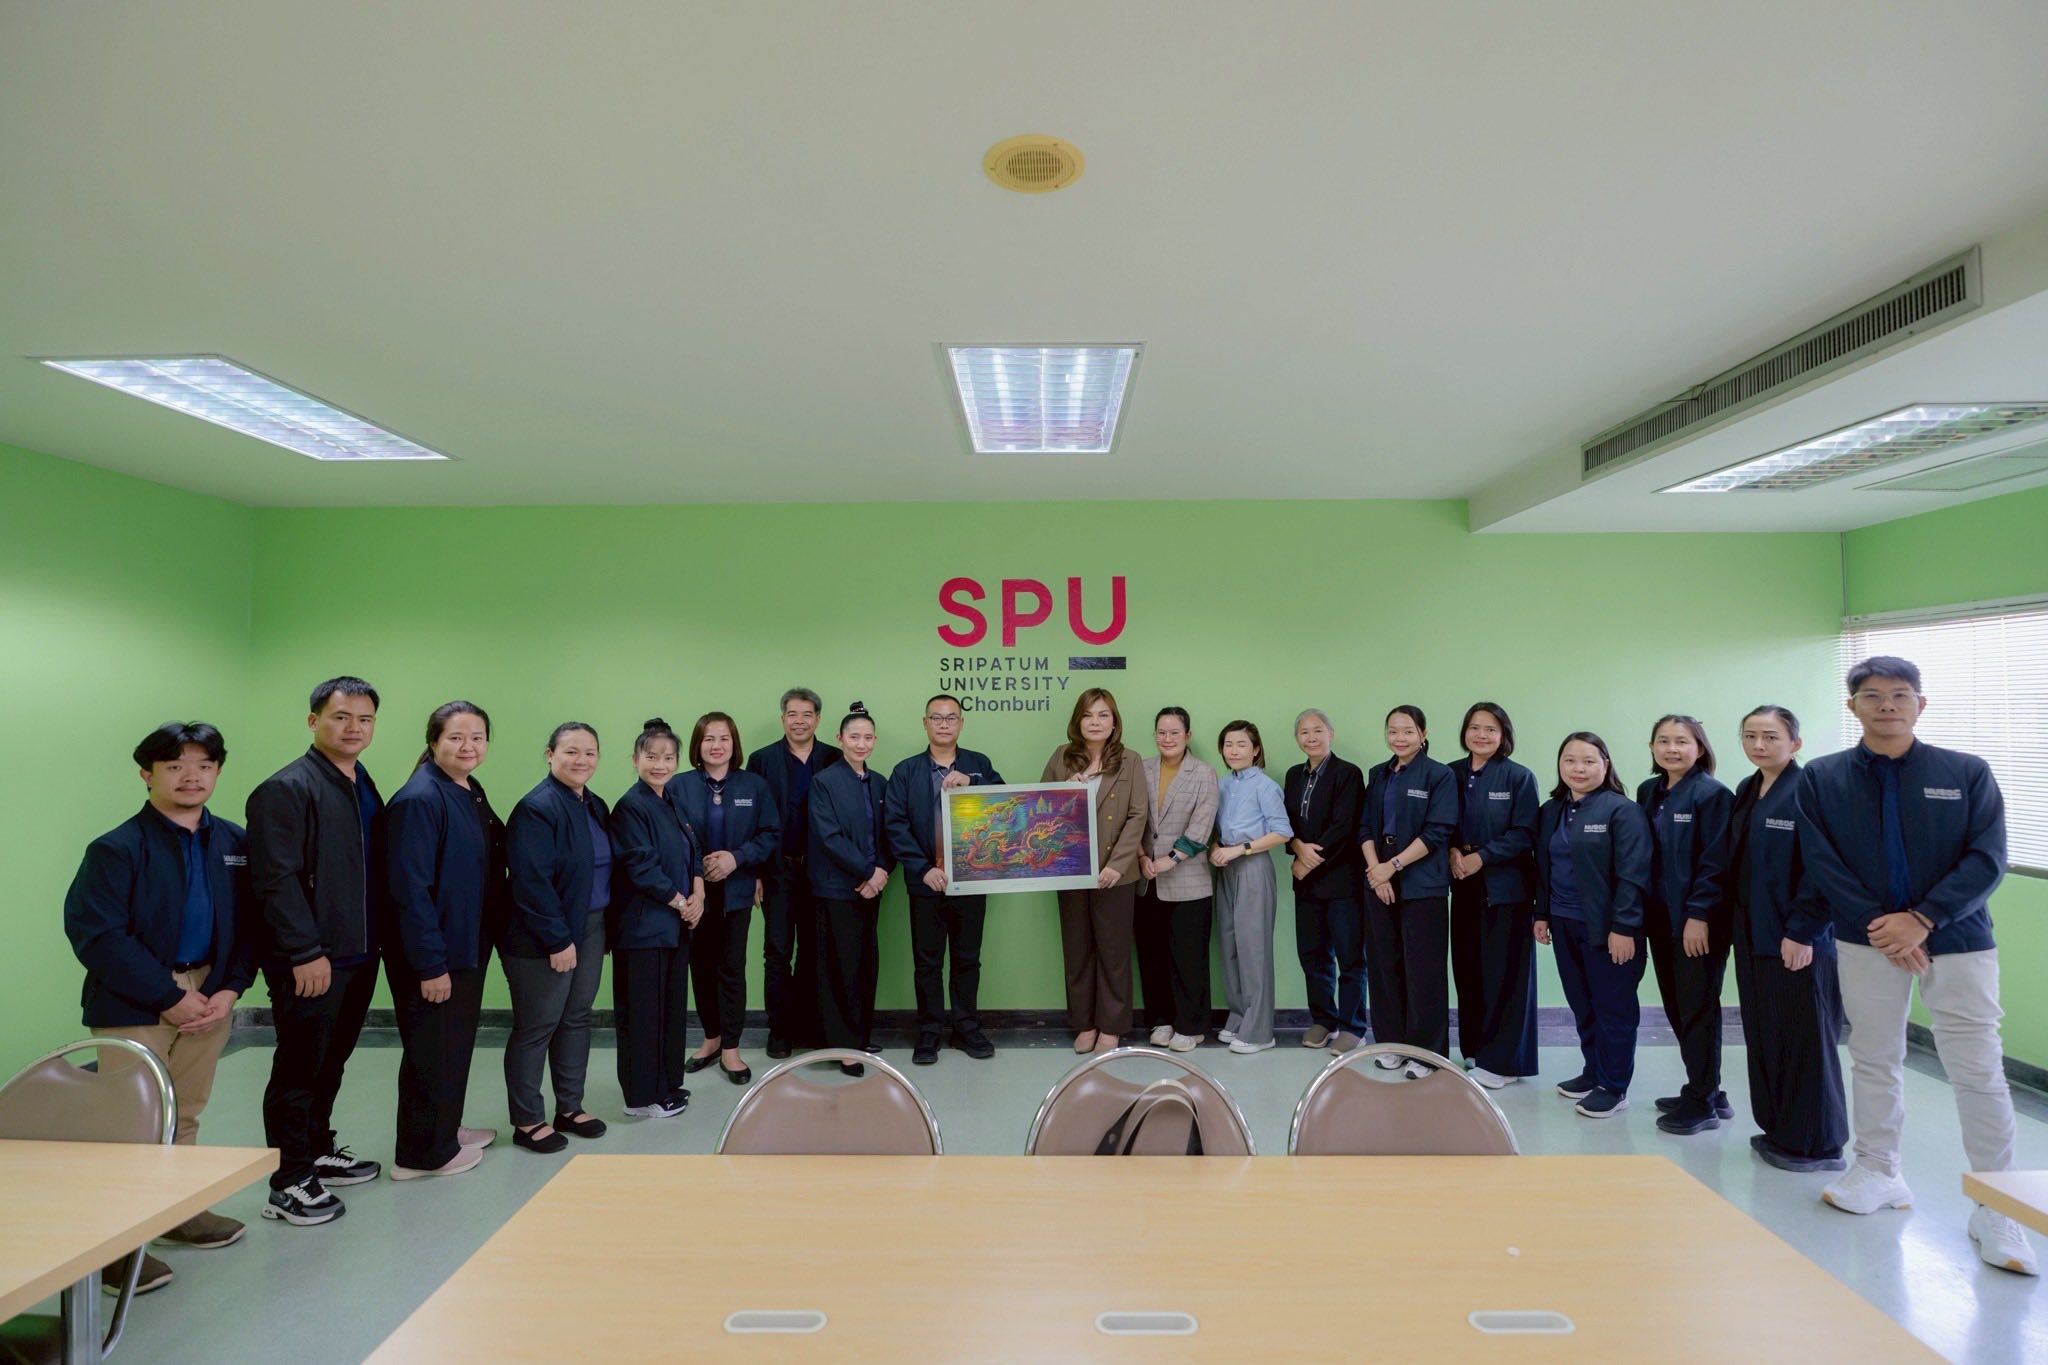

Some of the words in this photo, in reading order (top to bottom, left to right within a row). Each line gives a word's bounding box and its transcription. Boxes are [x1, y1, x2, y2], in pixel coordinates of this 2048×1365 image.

[937, 576, 1126, 647] SPU
[940, 657, 1049, 671] SRIPATUM
[940, 676, 1069, 691] UNIVERSITY
[961, 696, 1050, 711] Chonburi
